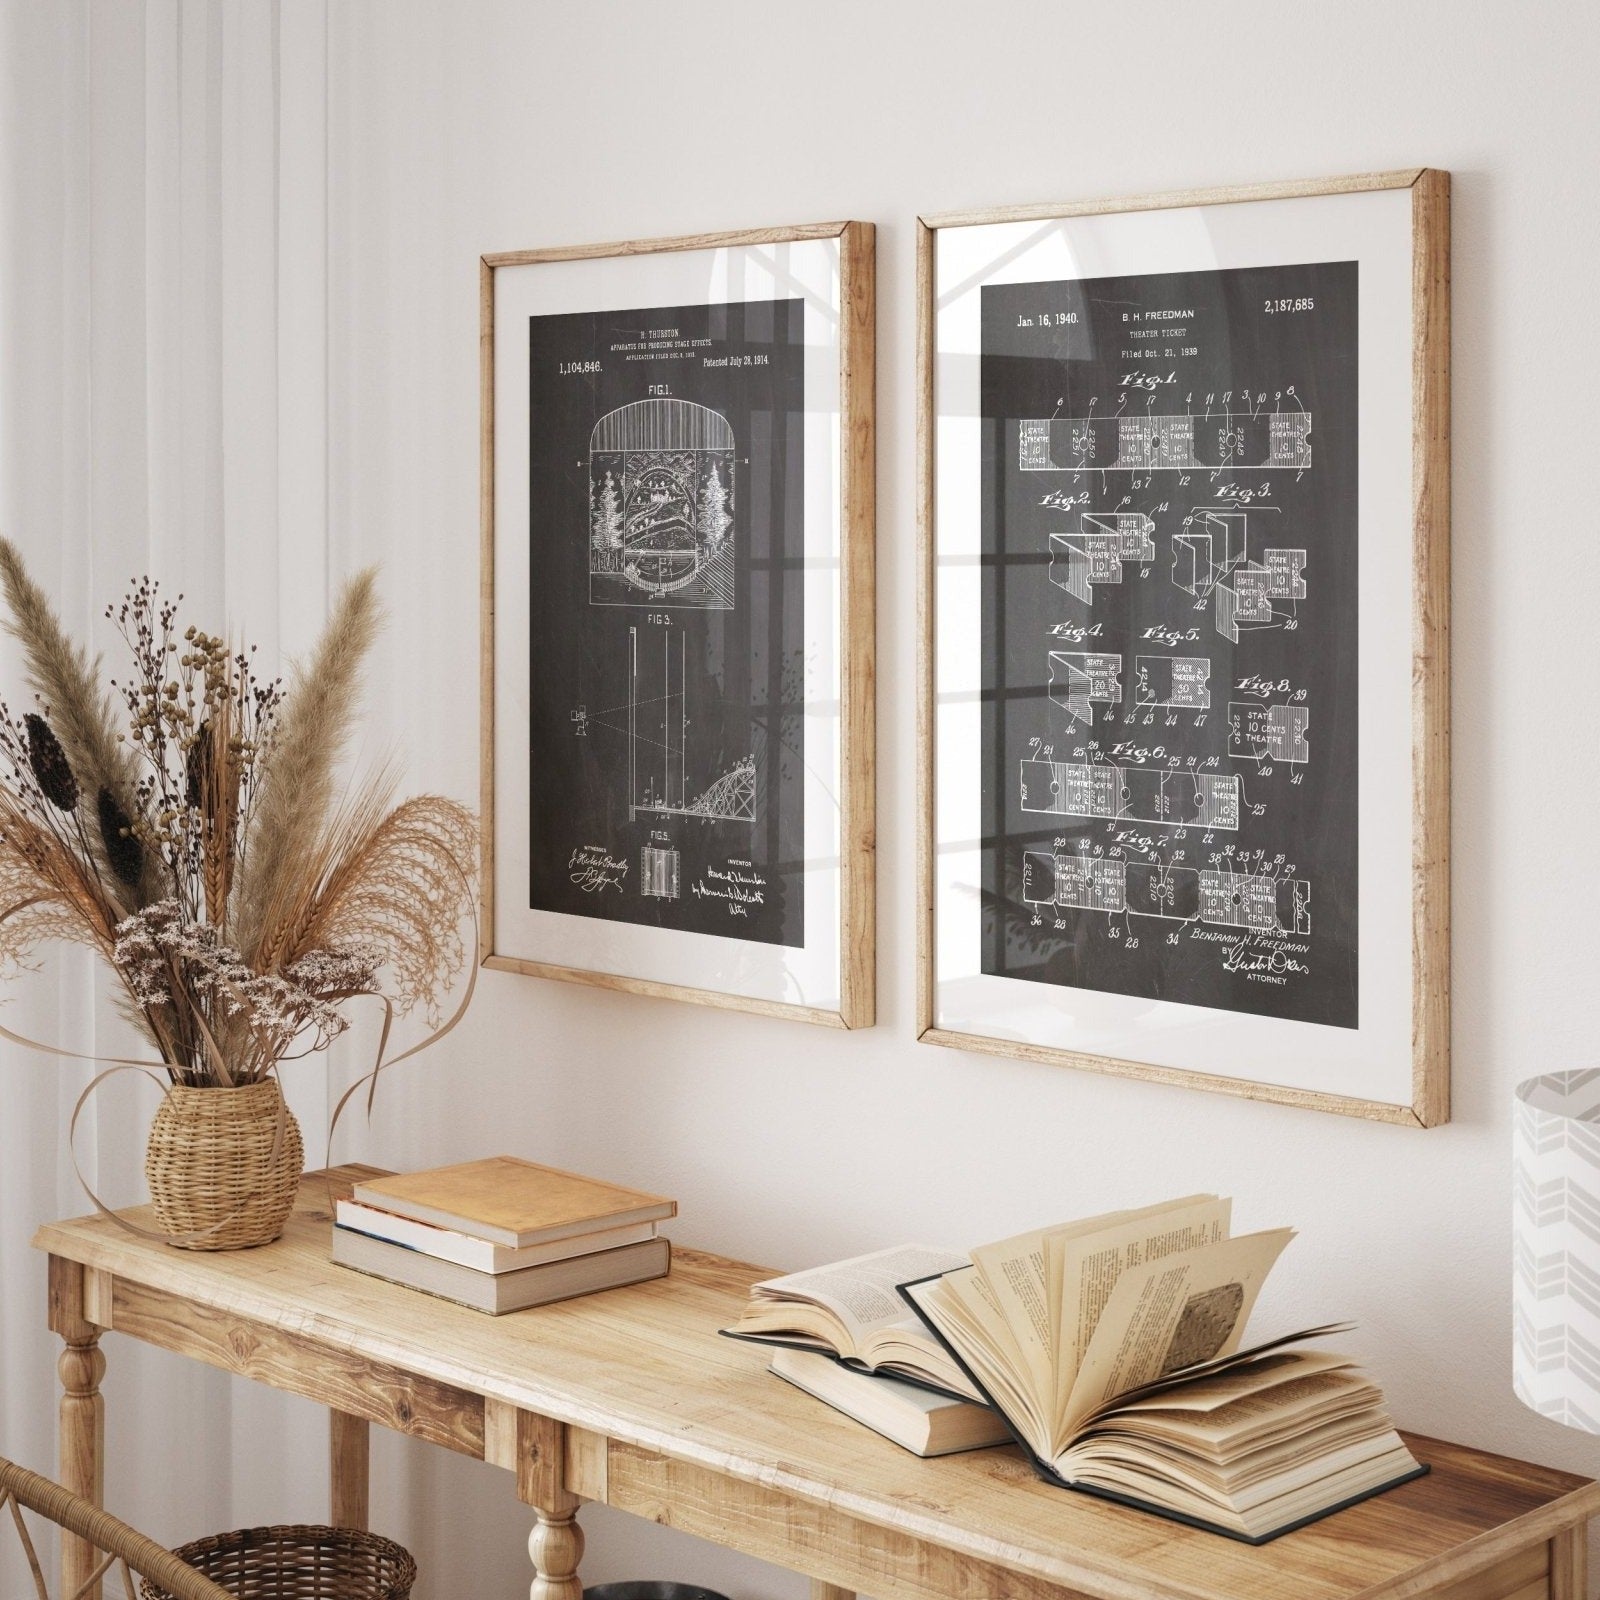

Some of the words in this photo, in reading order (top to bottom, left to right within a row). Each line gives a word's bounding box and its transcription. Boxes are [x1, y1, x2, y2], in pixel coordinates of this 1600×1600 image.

[1264, 298, 1314, 314] 2,187,685
[1017, 314, 1034, 326] Jan.
[1038, 314, 1051, 327] 16,
[1056, 312, 1079, 324] 1940.
[1134, 313, 1142, 321] H.
[1145, 310, 1194, 320] FREEDMAN
[1130, 330, 1158, 338] THEATER
[1162, 328, 1186, 337] TICKET
[1122, 350, 1142, 358] Filed
[1145, 350, 1160, 358] Oct.
[1164, 349, 1176, 357] 21,
[1181, 347, 1197, 356] 1939
[703, 358, 728, 367] Patented
[730, 357, 742, 367] July
[754, 355, 769, 365] 1914.
[559, 361, 602, 375] 1,104,846.
[1242, 390, 1249, 399] 3
[1287, 386, 1295, 395] 8
[1222, 392, 1232, 403] 17
[1275, 392, 1281, 400] 9
[1057, 397, 1064, 406] 6
[1182, 516, 1194, 526] 19
[1193, 599, 1207, 611] 42
[1284, 620, 1297, 630] 20
[1194, 715, 1207, 726] 47
[1248, 712, 1273, 720] STATE
[1249, 722, 1258, 731] 10
[1261, 725, 1286, 734] CENTS
[1246, 734, 1282, 744] THEATRE
[1206, 756, 1220, 767] 24
[1258, 767, 1272, 776] 40
[1291, 773, 1303, 785] 41
[1252, 804, 1267, 815] 25
[1175, 829, 1186, 839] 23
[1203, 834, 1214, 843] 22
[1054, 837, 1066, 847] 28
[1109, 847, 1121, 856] 28
[1172, 850, 1185, 860] 32
[1222, 845, 1235, 856] 32
[728, 859, 752, 867] INVENTOR
[1208, 853, 1221, 863] 38
[1274, 854, 1285, 864] 28
[1260, 862, 1272, 871] 30
[1284, 864, 1296, 873] 29
[1054, 919, 1066, 929] 28
[1109, 927, 1120, 938] 35
[1250, 928, 1288, 939] INVENTOR
[1125, 937, 1139, 948] 28
[1166, 933, 1180, 945] 34
[1191, 928, 1240, 942] BENJAMIN
[1254, 936, 1310, 953] FREEDMAN
[1246, 973, 1288, 985] ATTORNEY
